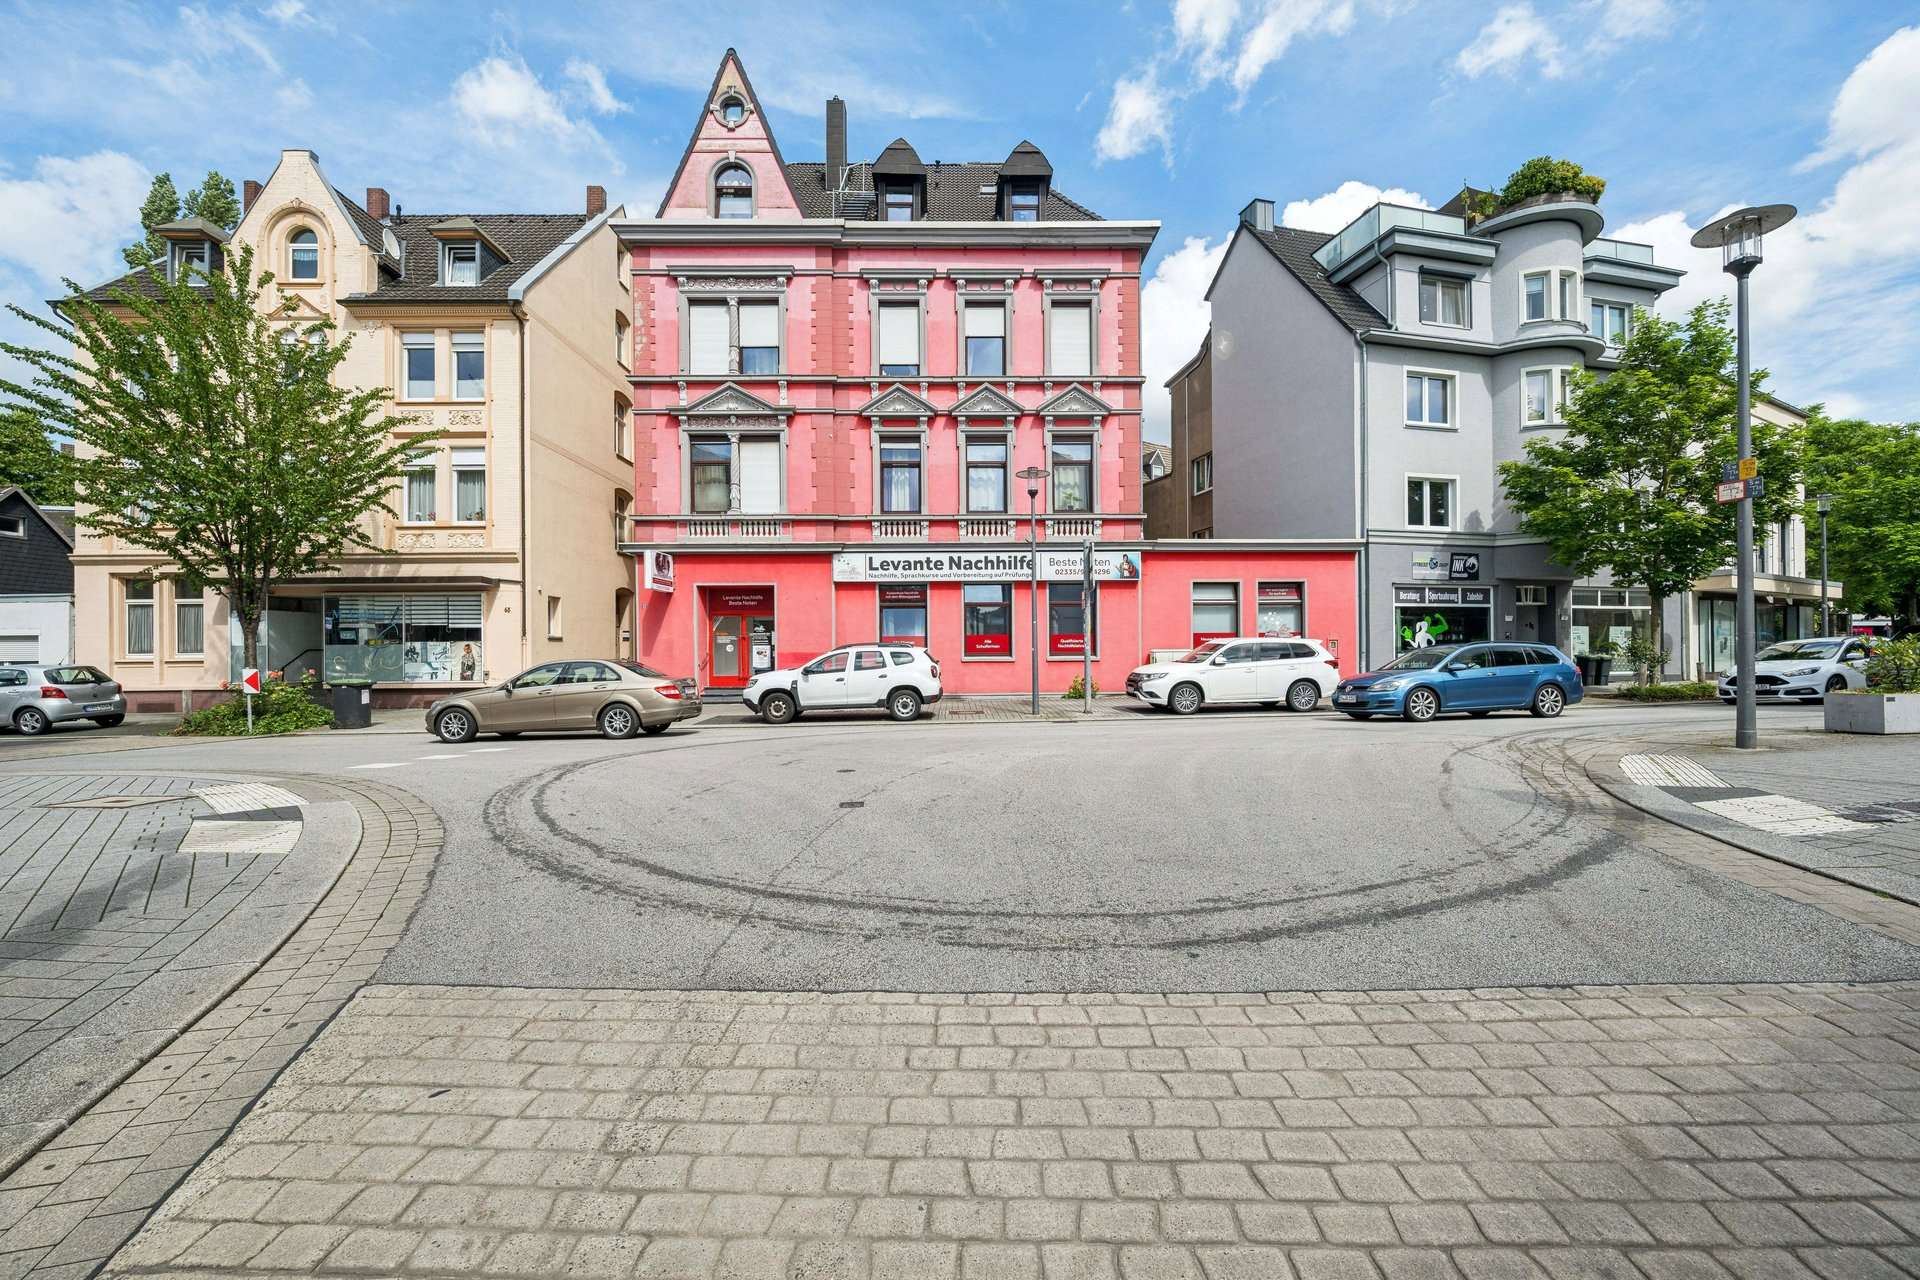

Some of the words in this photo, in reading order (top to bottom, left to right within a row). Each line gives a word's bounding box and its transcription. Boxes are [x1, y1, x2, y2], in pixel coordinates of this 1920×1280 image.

[868, 556, 944, 571] Levante
[948, 555, 1033, 570] Nachhilfe
[1049, 557, 1078, 567] Beste
[1452, 559, 1466, 572] INK
[900, 572, 939, 580] Sprachkurse
[952, 571, 993, 579] Vorbereitung
[1399, 591, 1420, 602] Beratung
